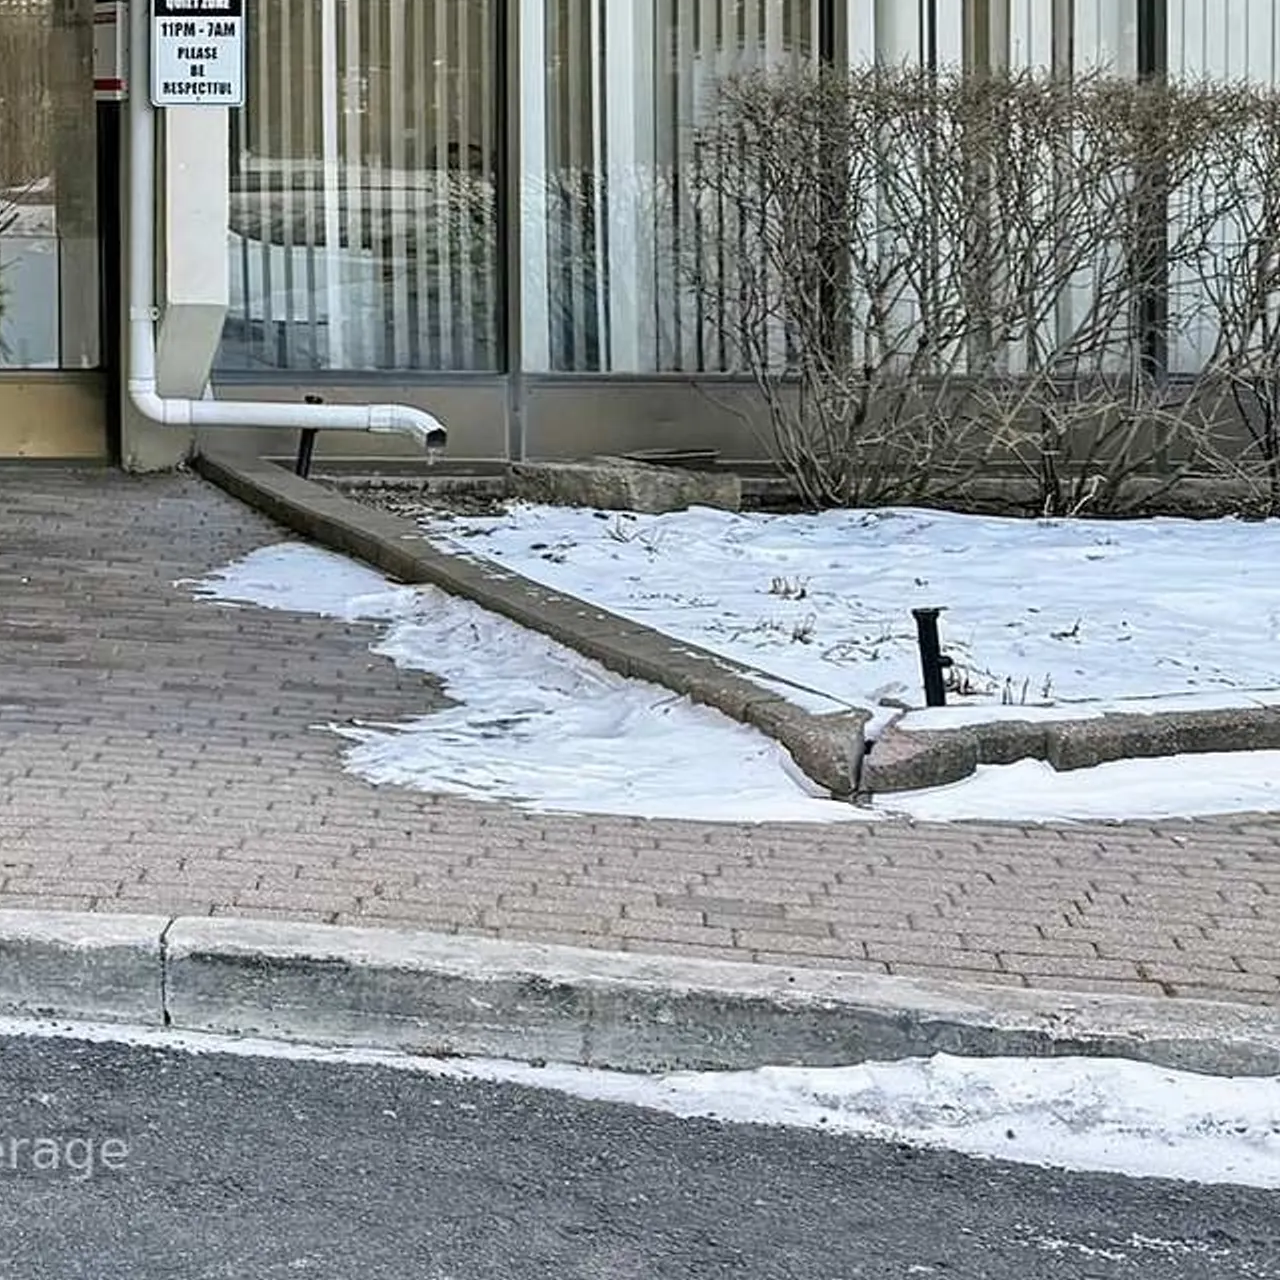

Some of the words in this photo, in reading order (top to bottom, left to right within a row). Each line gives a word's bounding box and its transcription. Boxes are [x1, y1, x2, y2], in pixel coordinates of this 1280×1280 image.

[161, 22, 192, 37] 11PM
[207, 22, 236, 37] 7AM
[177, 46, 218, 60] PLEASE
[190, 64, 204, 77] BE
[163, 82, 232, 96] RESPECTFUL
